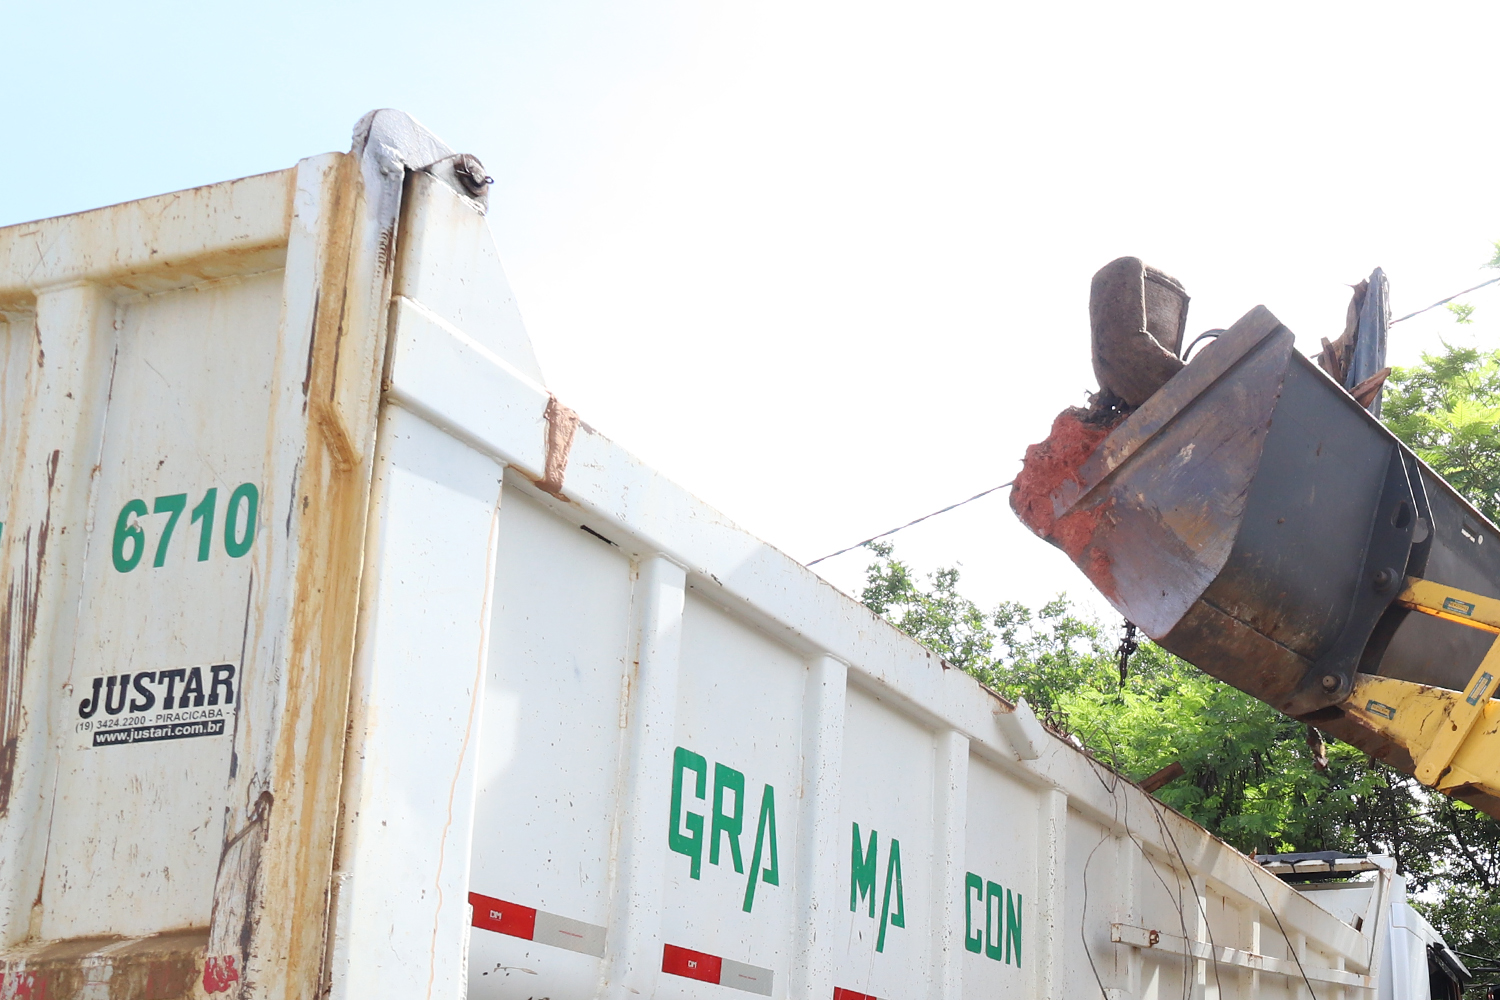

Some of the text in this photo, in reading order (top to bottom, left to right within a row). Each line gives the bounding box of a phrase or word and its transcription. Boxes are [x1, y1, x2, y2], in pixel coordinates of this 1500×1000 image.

[112, 482, 259, 573] 6710
[75, 720, 93, 733] (19)
[96, 716, 146, 729] 3424.2200
[155, 709, 223, 724] PIRACICABA
[96, 721, 222, 743] www.justari.com.br
[669, 746, 1023, 968] GRA MA CON
